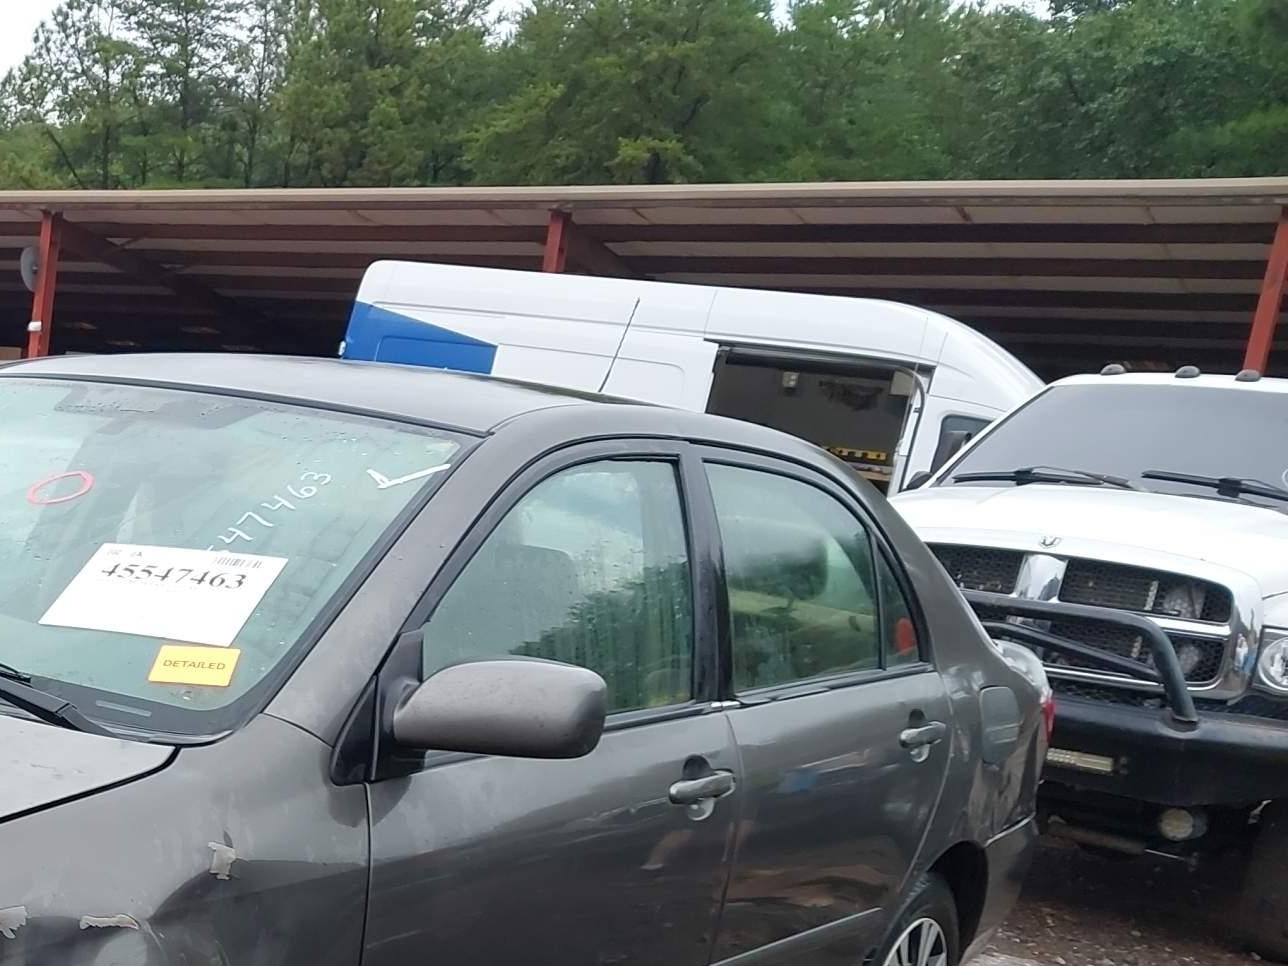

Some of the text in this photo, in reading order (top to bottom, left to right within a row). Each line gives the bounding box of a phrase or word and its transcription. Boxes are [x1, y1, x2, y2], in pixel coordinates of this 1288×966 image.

[206, 470, 332, 553] 47463
[101, 563, 247, 589] 45547463
[162, 658, 227, 671] DETAILED
